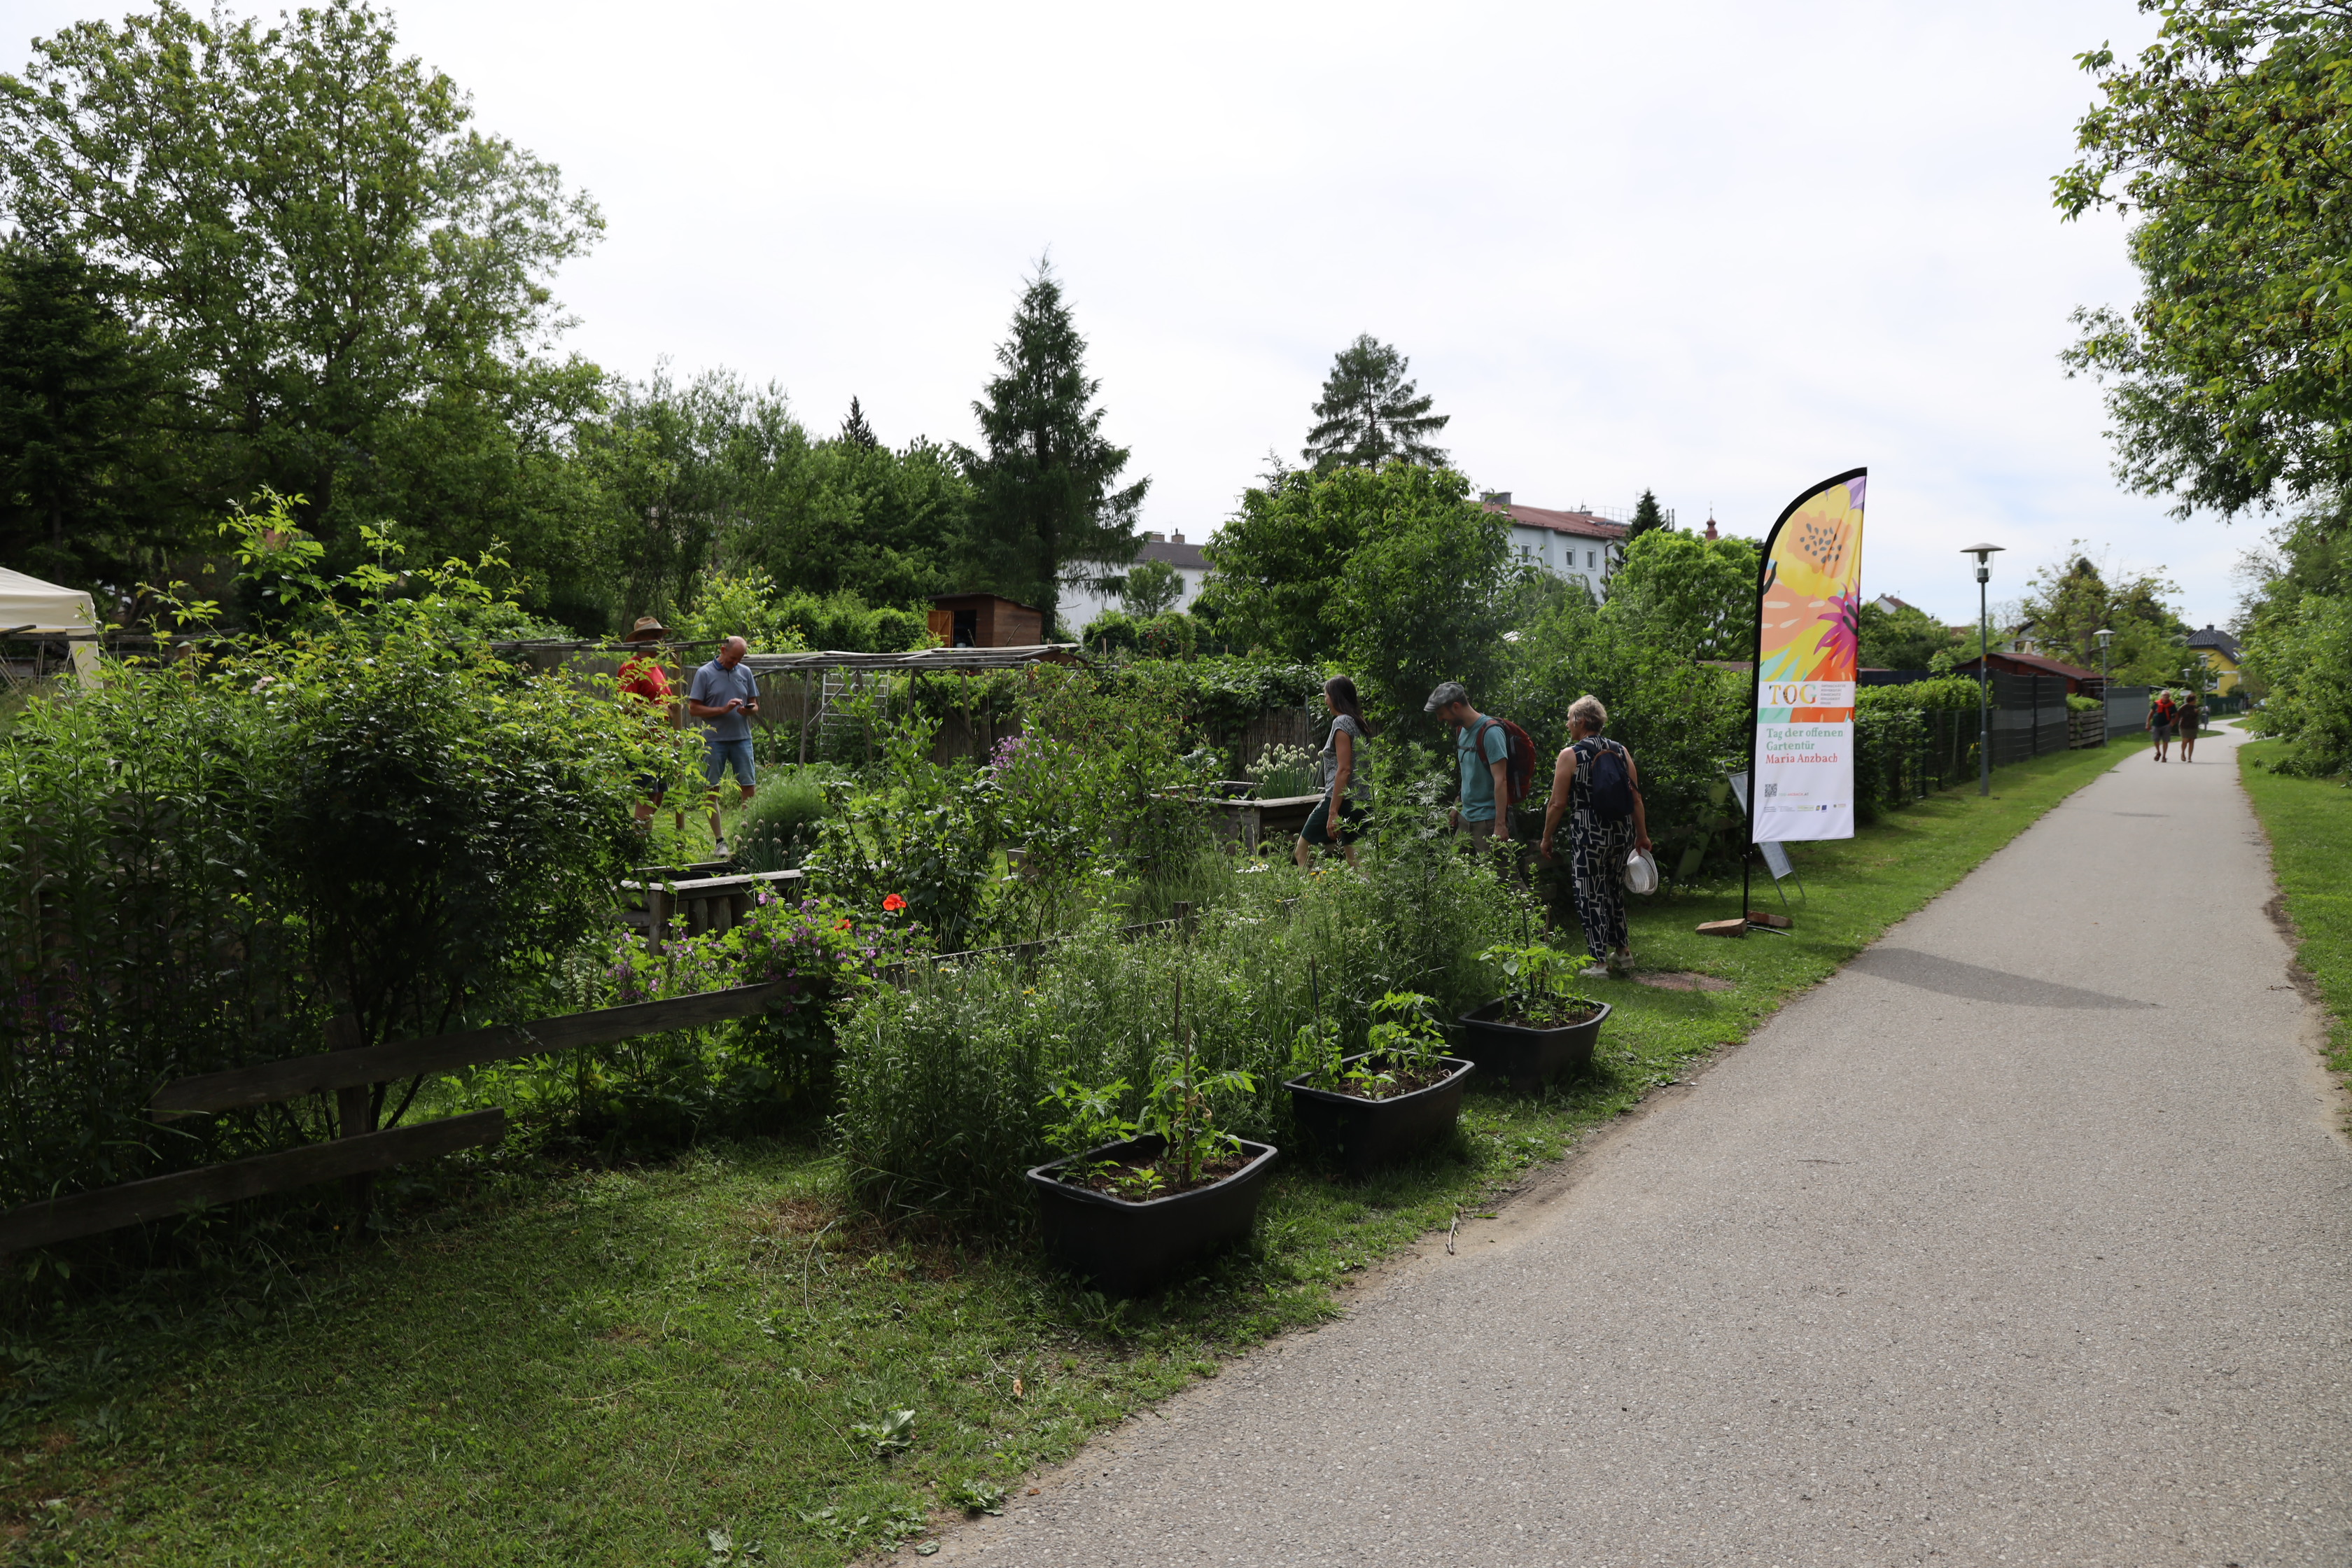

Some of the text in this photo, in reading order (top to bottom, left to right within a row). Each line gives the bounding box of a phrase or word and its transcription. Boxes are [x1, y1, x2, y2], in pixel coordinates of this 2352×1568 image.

[1769, 684, 1817, 705] TOG
[1766, 727, 1844, 741] Tag der offenen
[1766, 741, 1815, 751] Gartentür
[1765, 752, 1838, 764] Maria Anzbach
